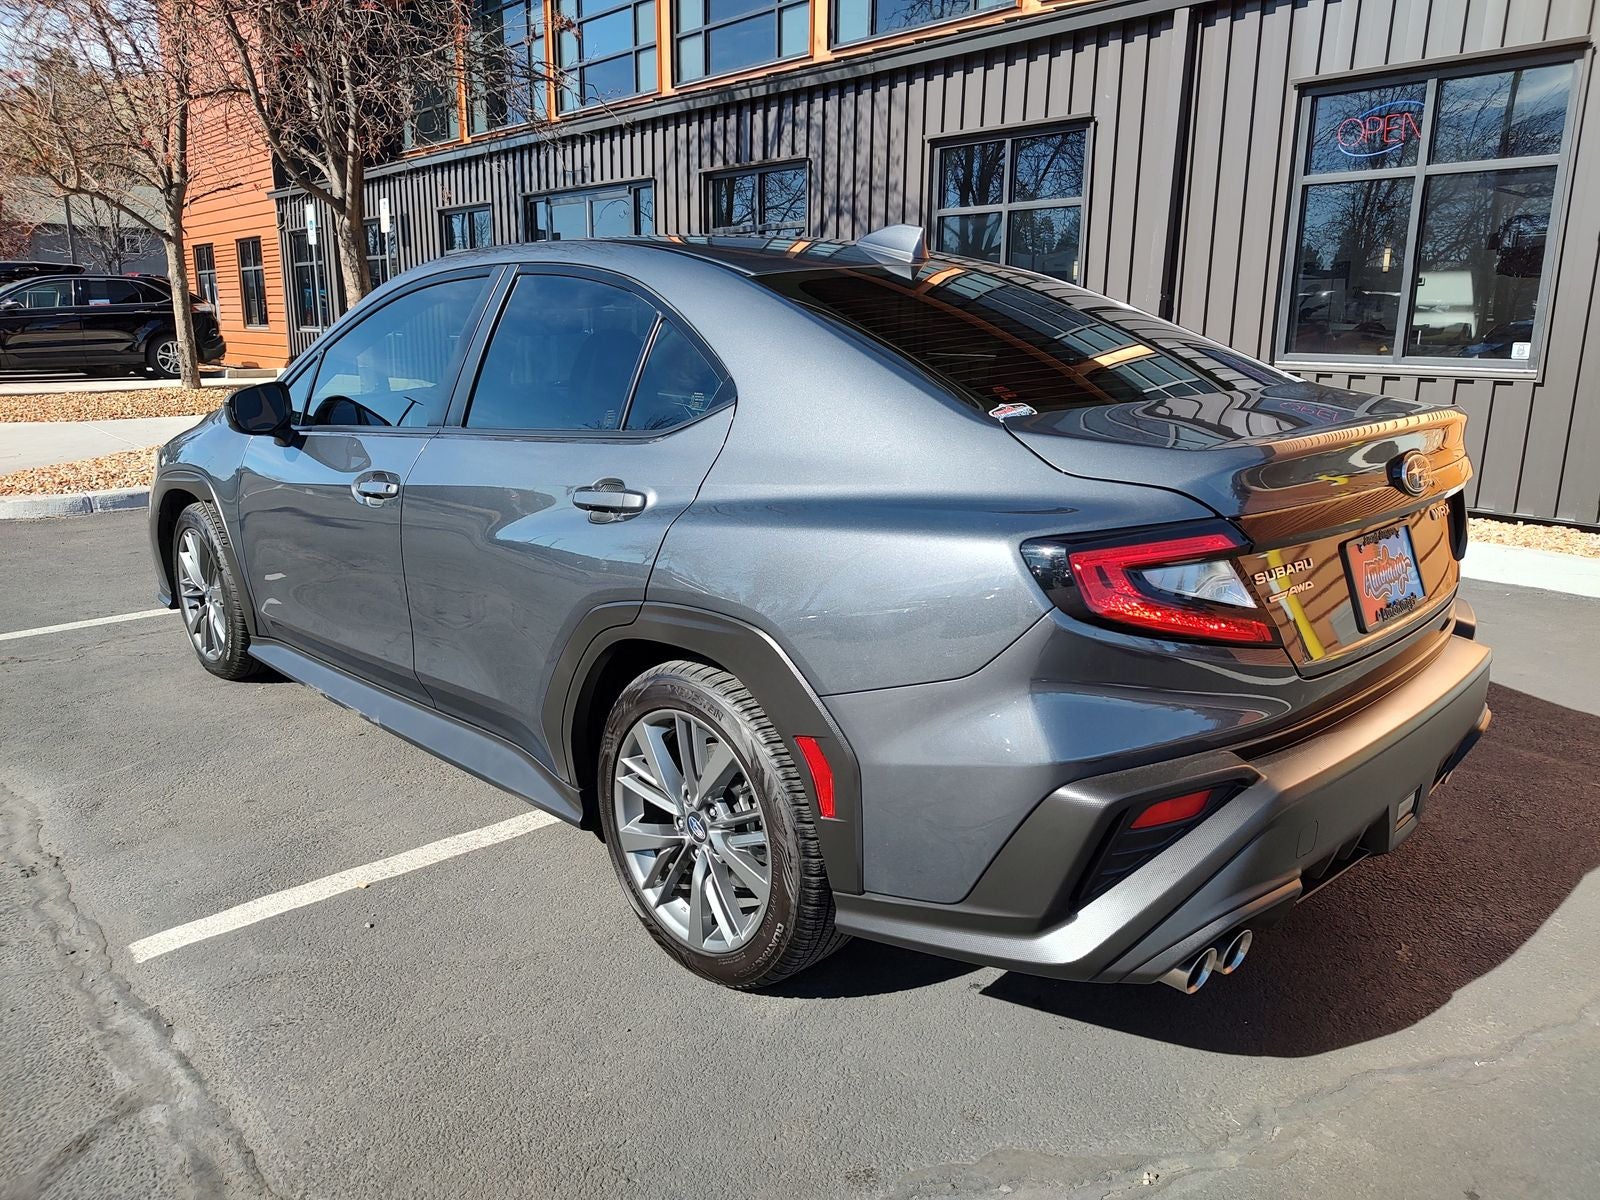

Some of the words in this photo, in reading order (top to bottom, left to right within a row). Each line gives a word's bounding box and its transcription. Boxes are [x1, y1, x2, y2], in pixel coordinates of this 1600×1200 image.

[1337, 112, 1421, 147] OPEN
[1429, 503, 1450, 520] WRX
[1252, 557, 1314, 585] SUBARU
[1288, 580, 1315, 597] AWD
